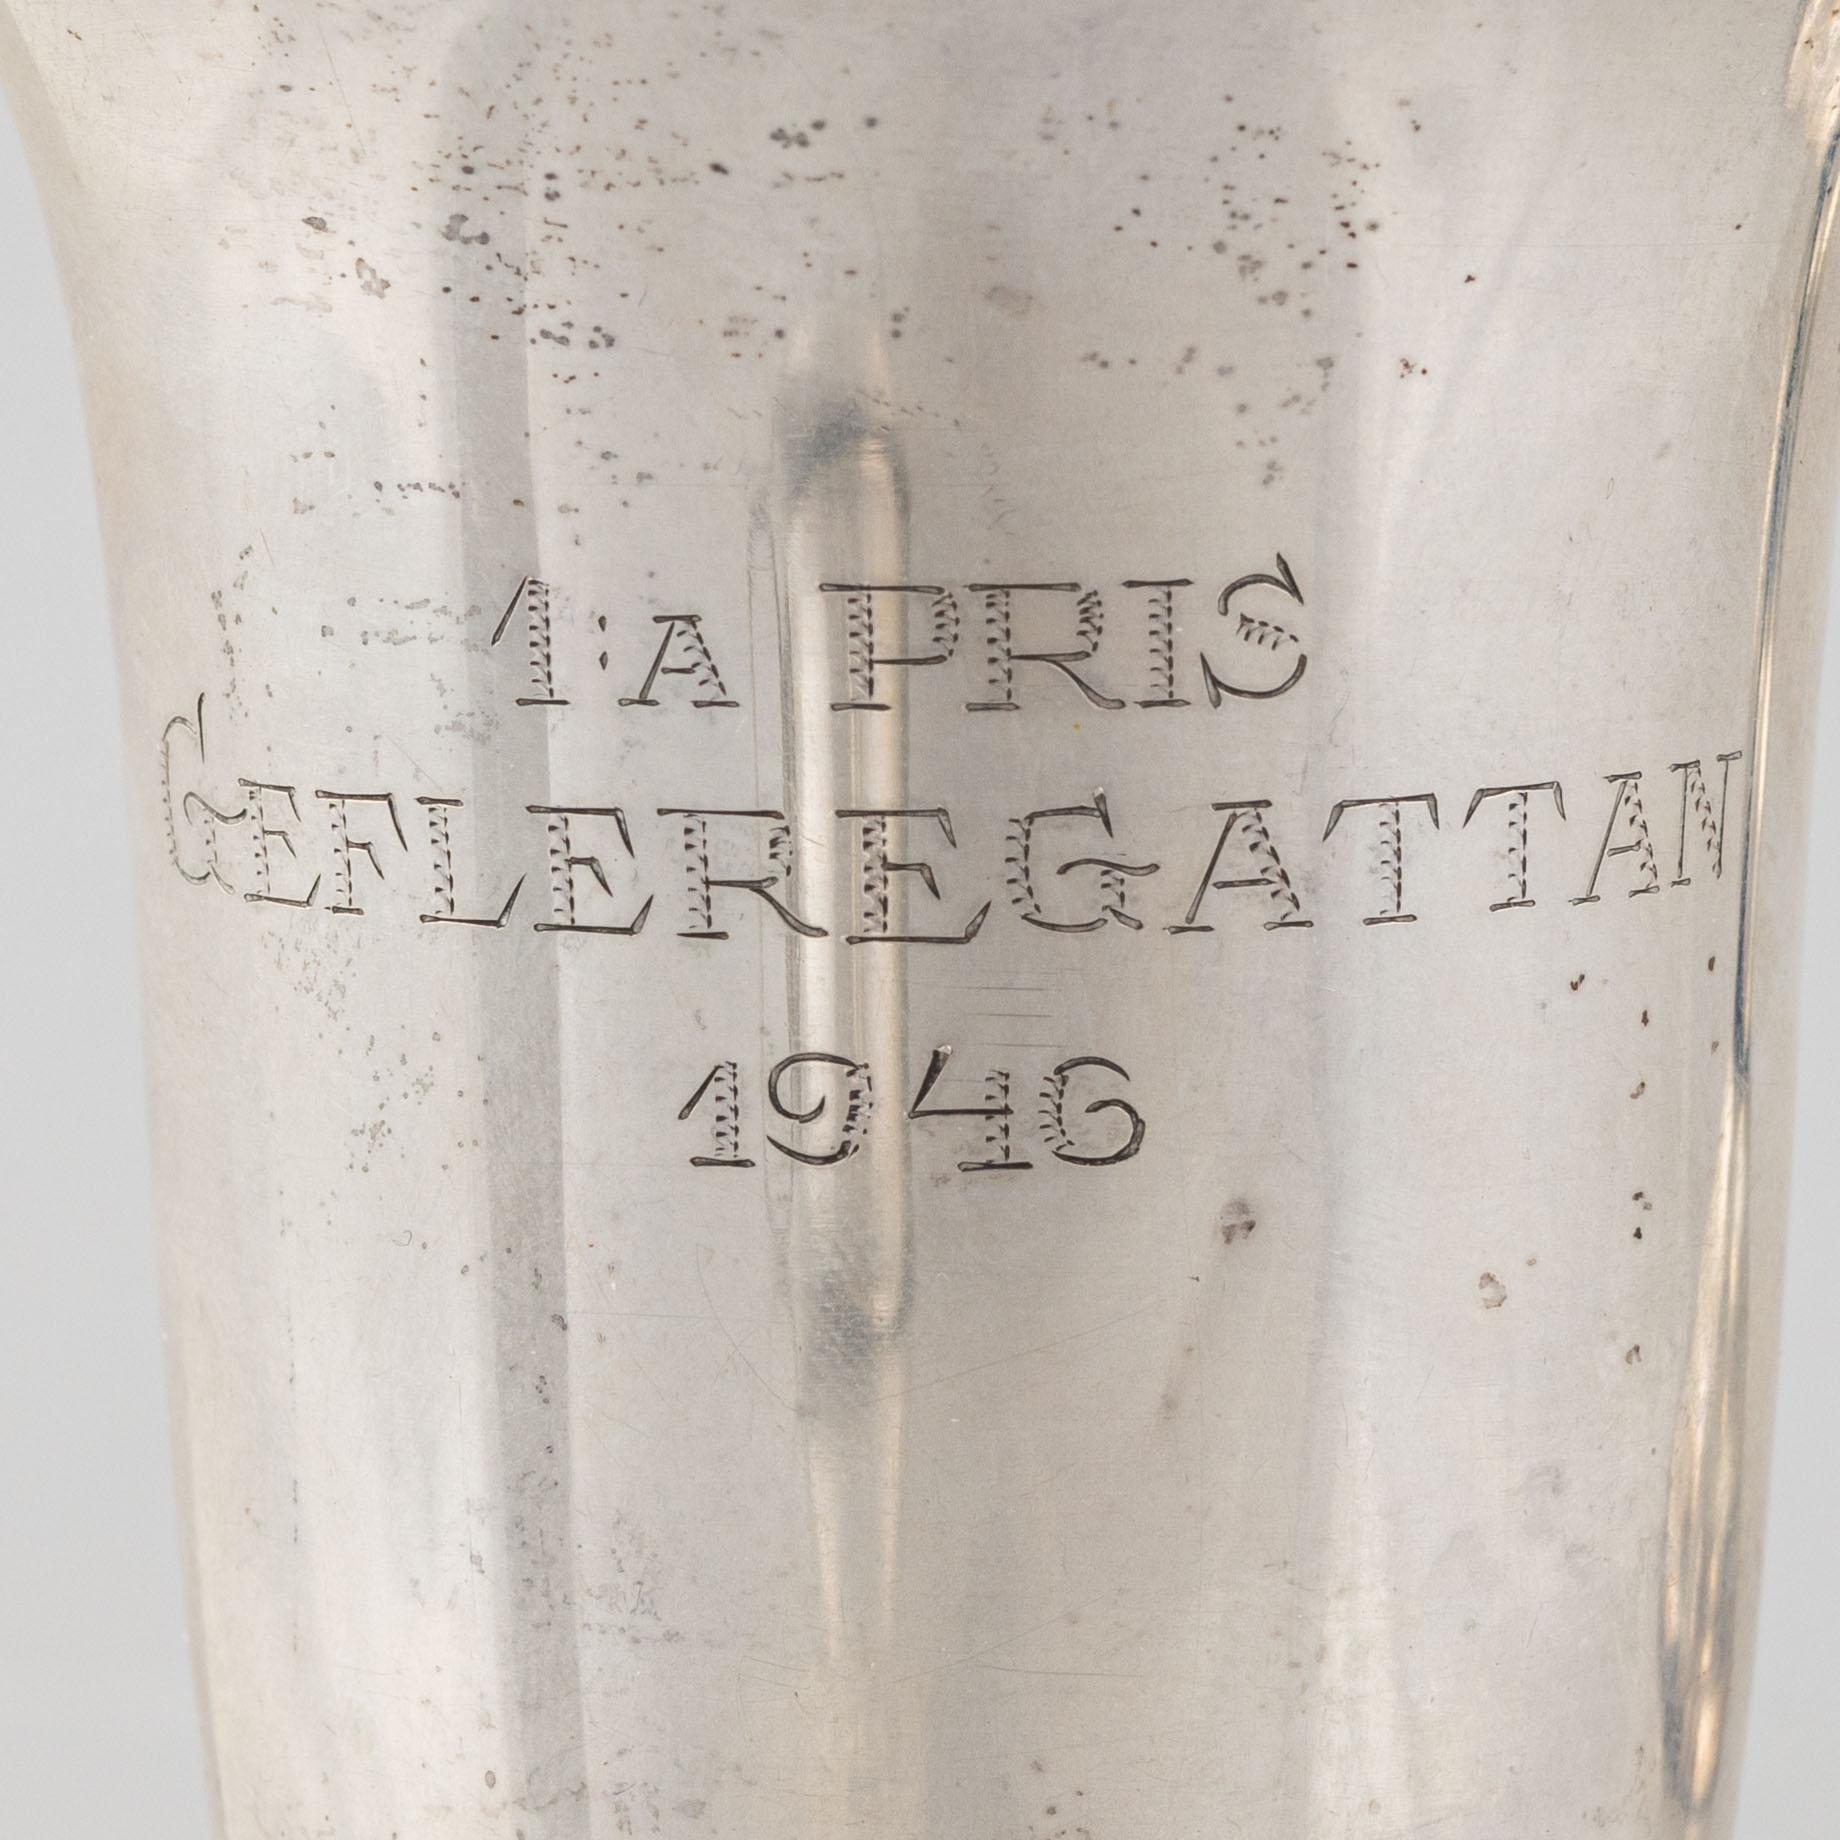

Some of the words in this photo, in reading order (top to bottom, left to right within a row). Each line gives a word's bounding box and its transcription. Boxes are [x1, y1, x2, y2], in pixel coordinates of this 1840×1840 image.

[819, 552, 1307, 711] PRIS
[162, 692, 1743, 944] GEFLEREGATTAN
[678, 1044, 1146, 1171] 1946
